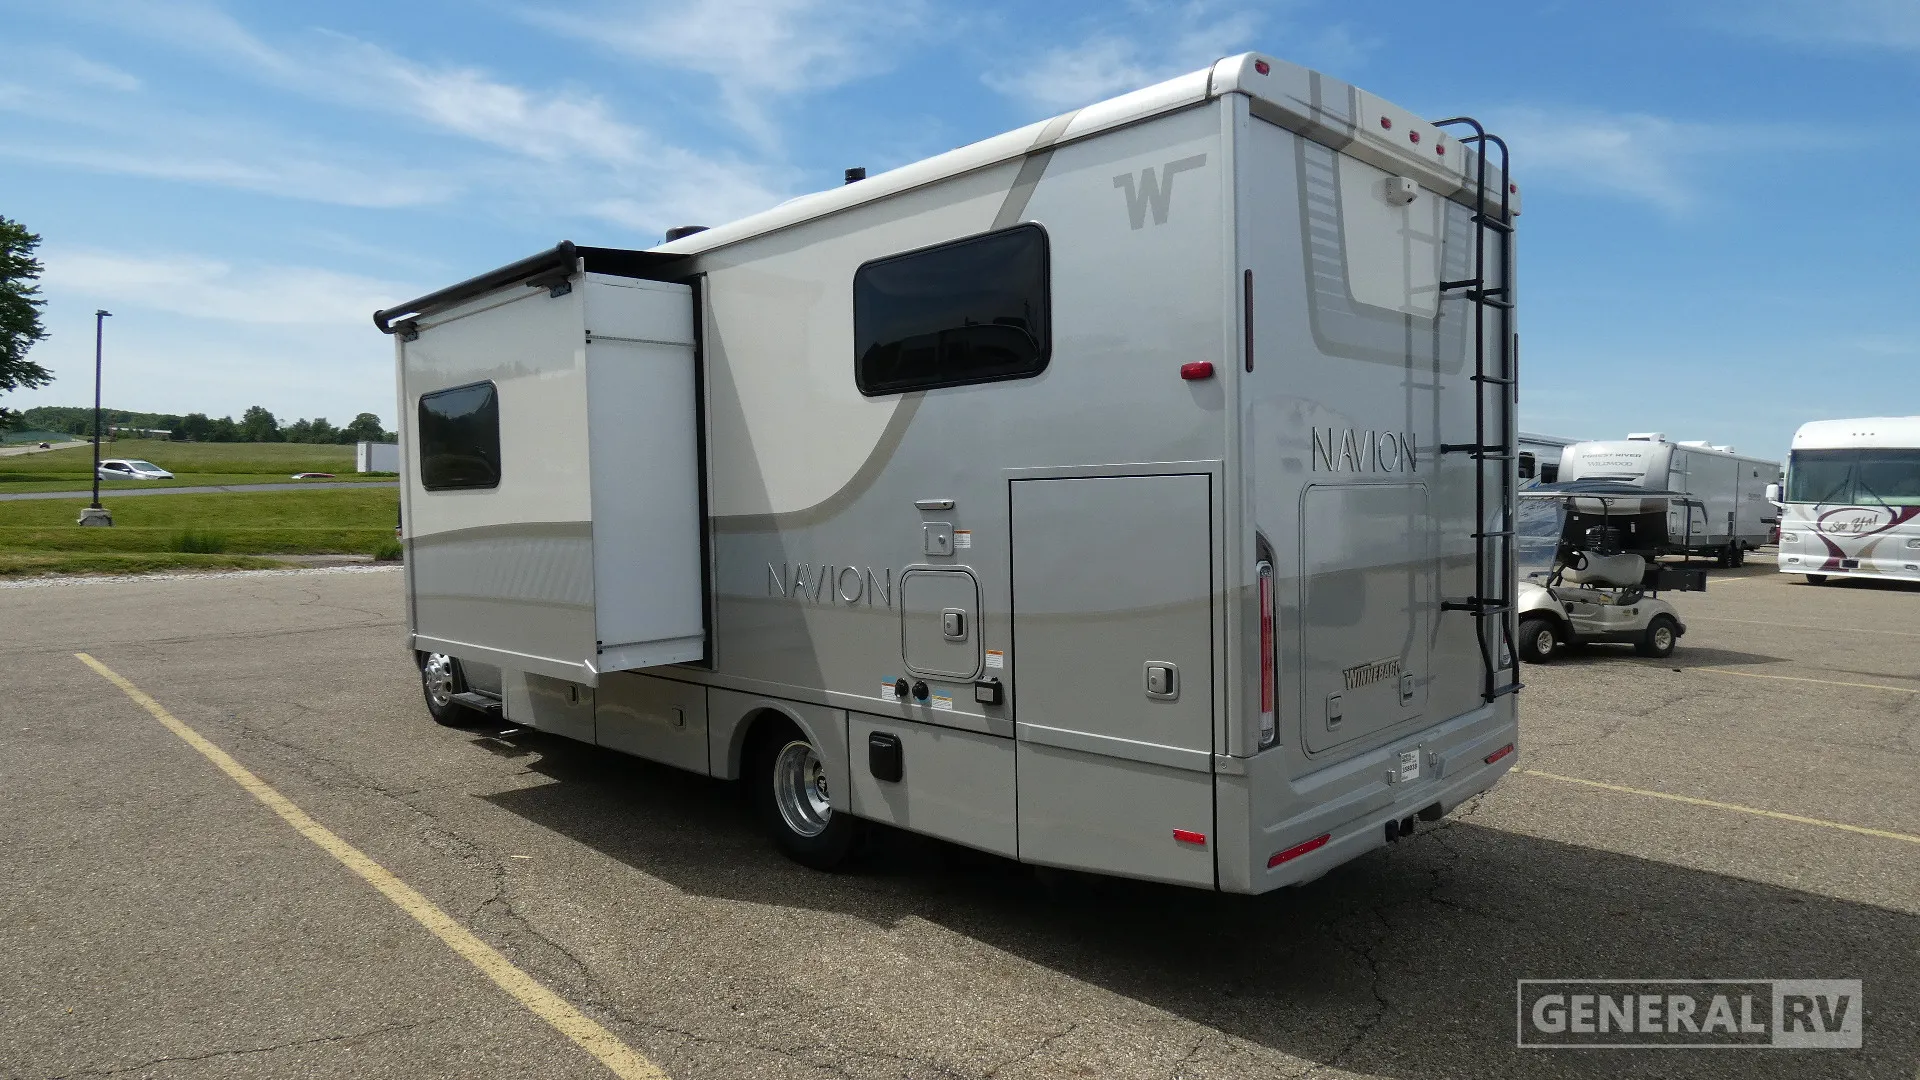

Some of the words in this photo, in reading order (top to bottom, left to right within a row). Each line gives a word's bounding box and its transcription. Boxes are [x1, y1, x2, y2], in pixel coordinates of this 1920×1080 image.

[1312, 426, 1416, 473] NAVION
[767, 561, 892, 606] NAVION
[1342, 660, 1402, 691] WINNEBAGO
